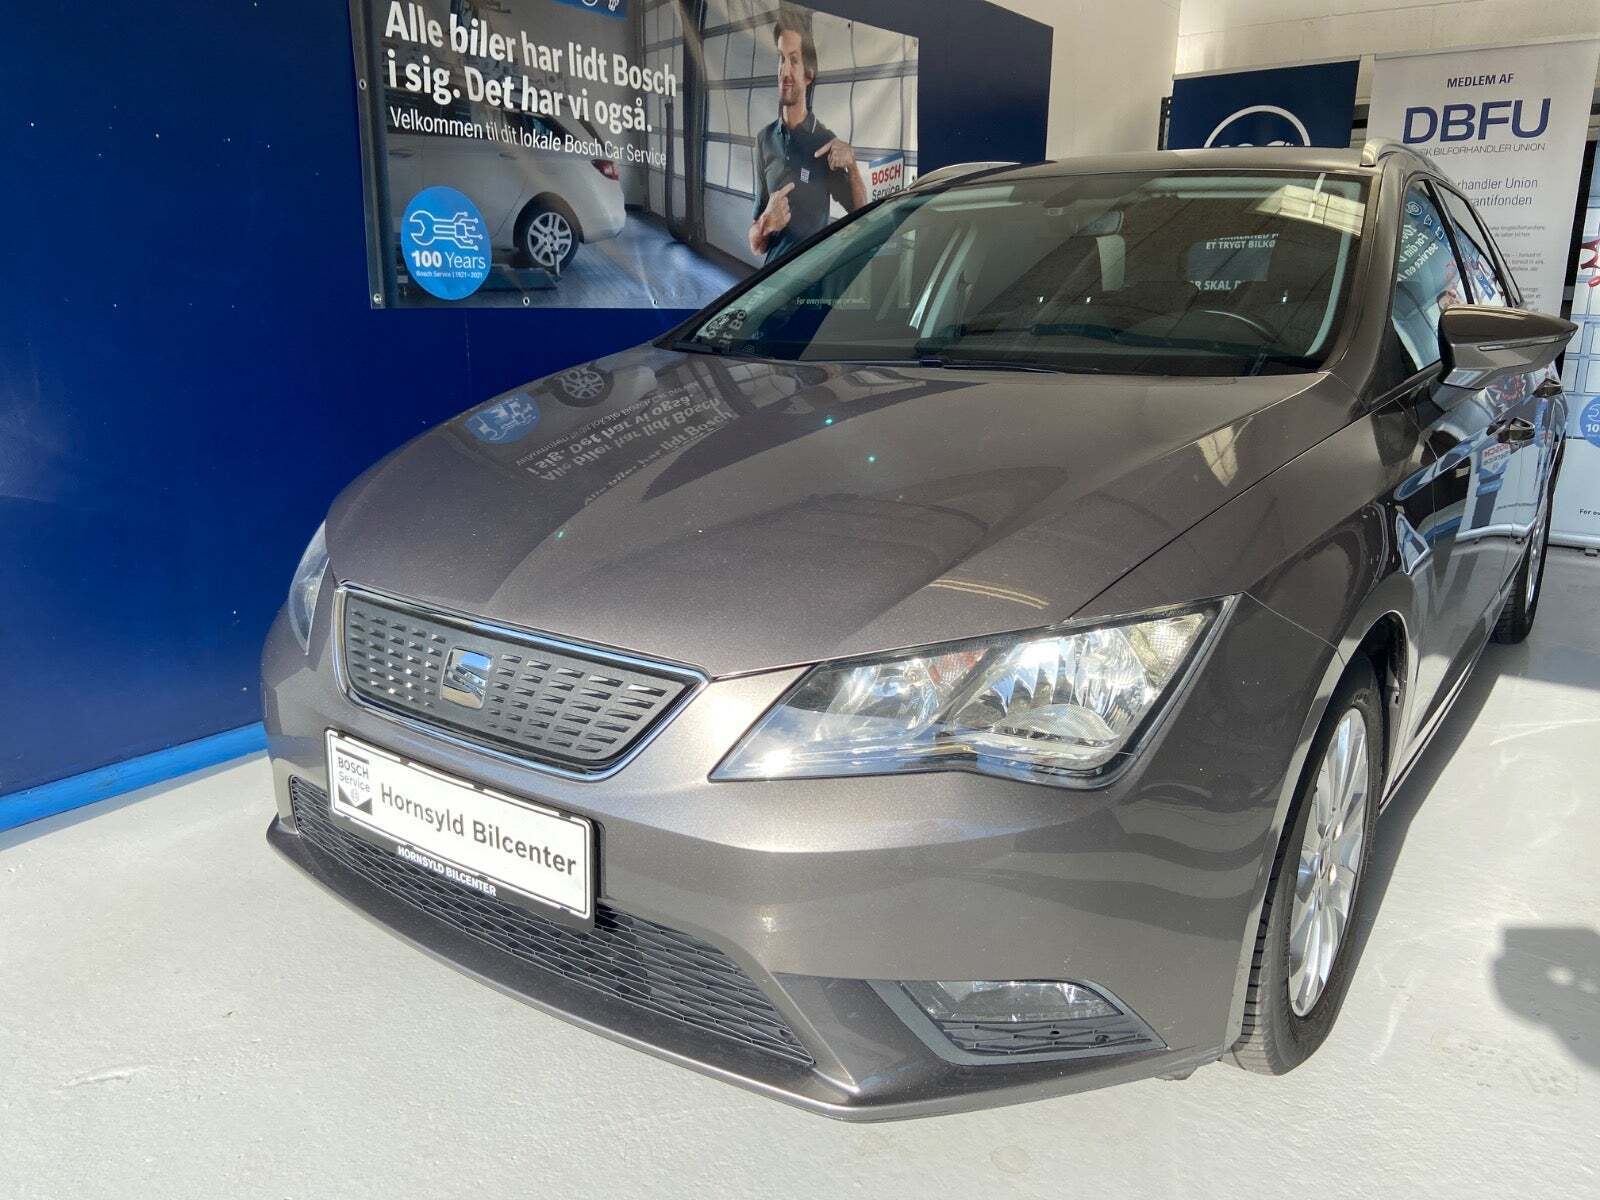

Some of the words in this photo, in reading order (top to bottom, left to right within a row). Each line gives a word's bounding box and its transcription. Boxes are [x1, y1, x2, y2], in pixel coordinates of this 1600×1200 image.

[385, 1, 443, 47] Alle
[450, 13, 516, 63] biler
[520, 30, 563, 73] har
[568, 42, 608, 84] lidt
[613, 53, 676, 97] Bosch
[1447, 74, 1496, 88] MEDLEM
[1499, 73, 1514, 84] AF
[387, 49, 397, 88] i
[405, 55, 460, 105] sig.
[464, 66, 514, 109] Det
[521, 75, 563, 117] har
[568, 88, 589, 121] vi
[595, 97, 652, 134] også.
[1403, 98, 1551, 144] DBFU
[390, 106, 483, 139] Velkommen
[486, 121, 498, 140] til
[501, 124, 517, 145] dit
[520, 127, 561, 151] lokale
[565, 134, 602, 156] Bosch
[605, 141, 624, 160] Car
[627, 144, 667, 167] Service
[1433, 144, 1511, 156] BILFORHANDLER
[1513, 142, 1546, 152] UNION
[872, 163, 901, 186] BOSCH
[1505, 177, 1538, 188] Union
[872, 184, 900, 201] Service
[1206, 241, 1216, 250] ET
[1218, 241, 1246, 249] TRYGT
[411, 250, 442, 268] 100
[444, 251, 486, 269] Years
[1204, 280, 1231, 290] SKAL
[338, 757, 369, 779] BOSCH
[339, 771, 370, 792] Service
[381, 781, 465, 837] Hornsyld
[473, 819, 576, 876] Bilcenter
[398, 845, 445, 875] HORNSYLD
[445, 867, 497, 897] BILCENTER
